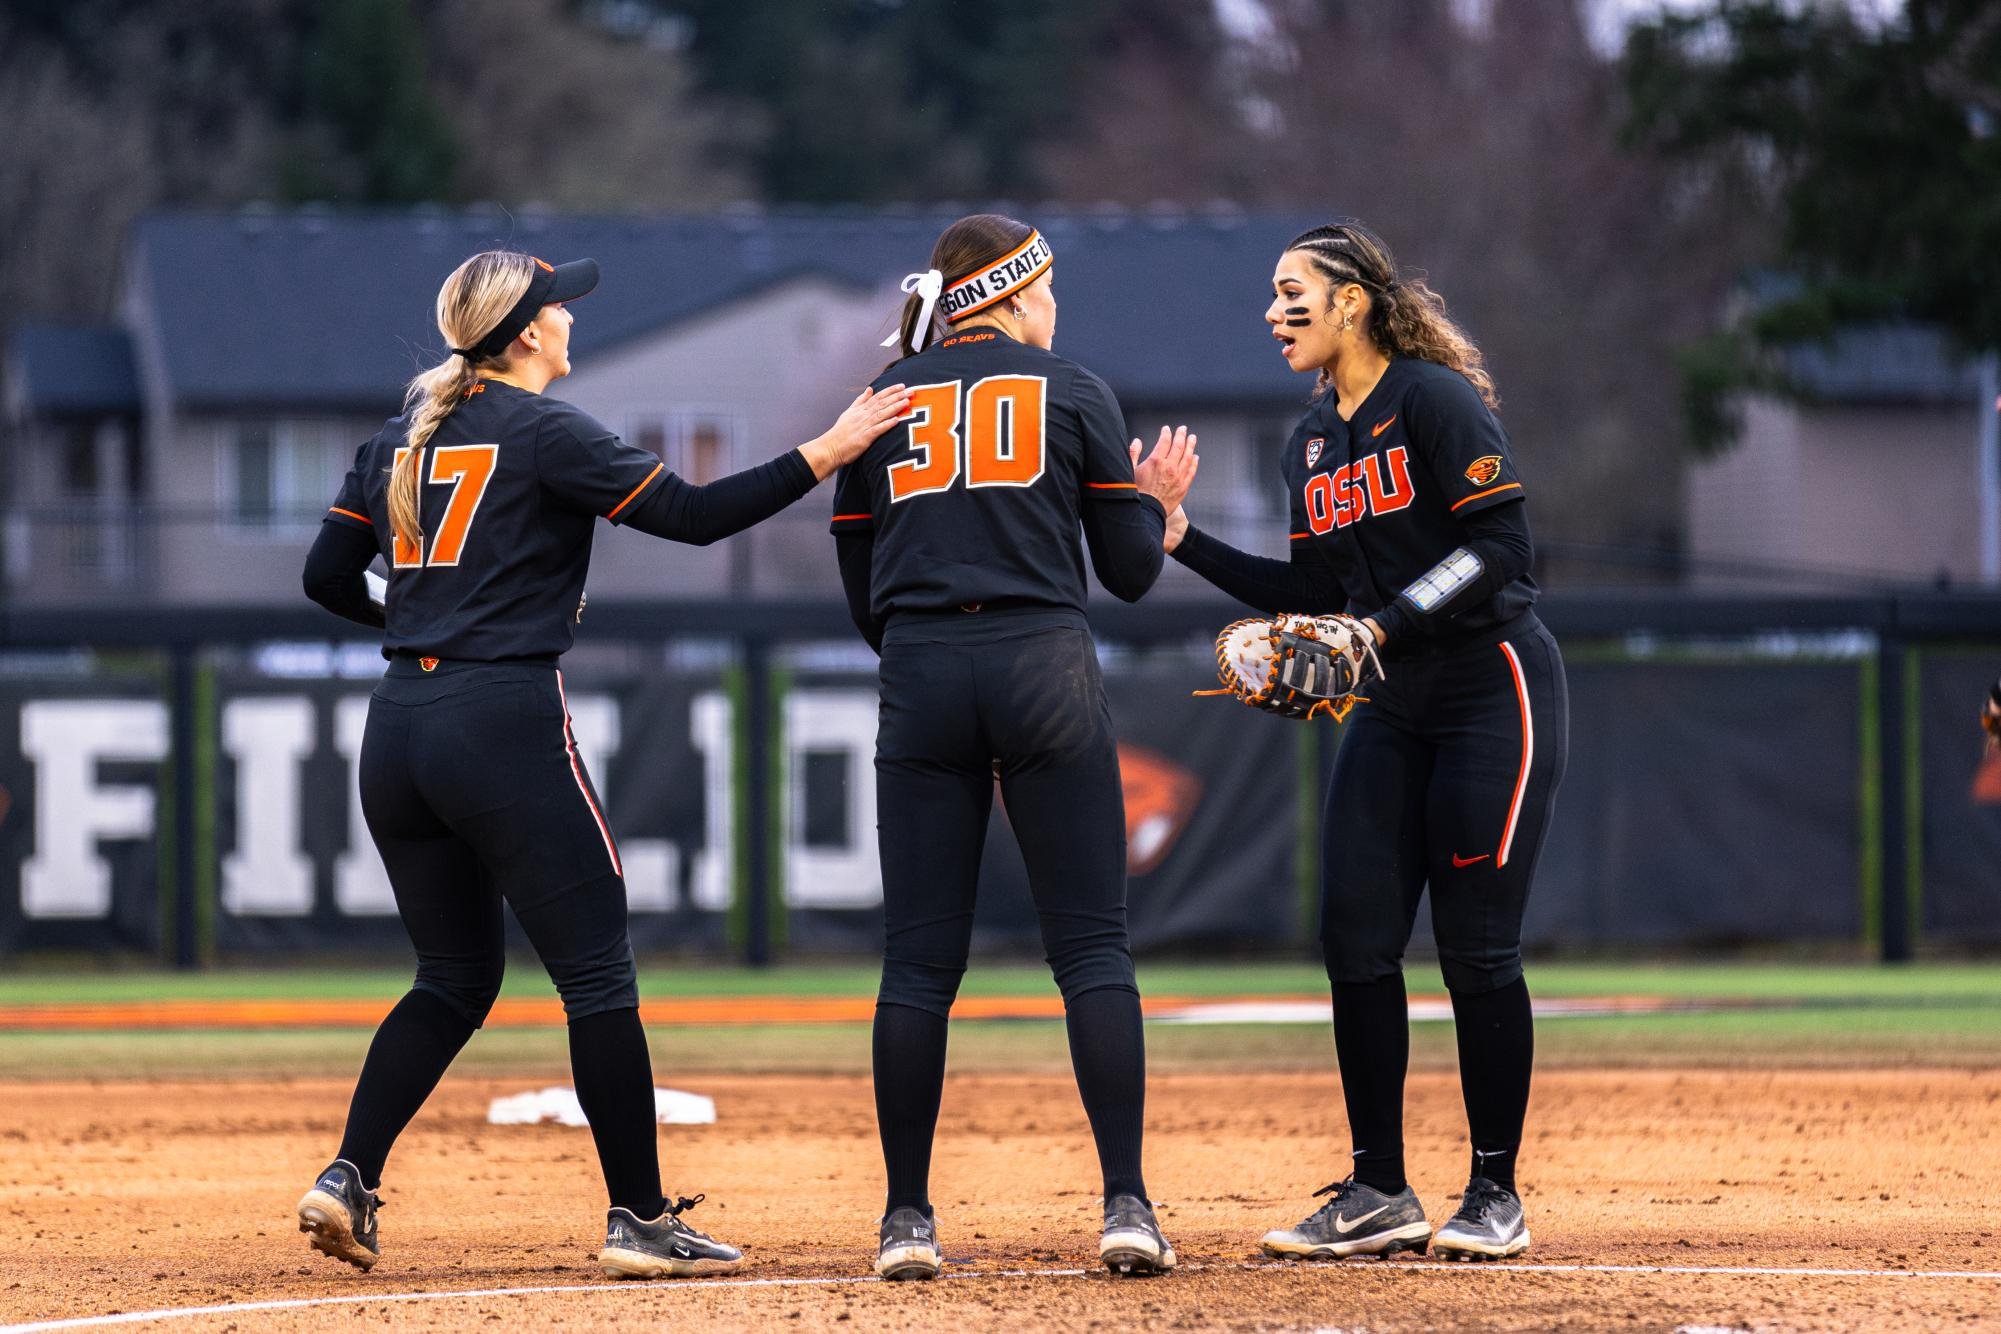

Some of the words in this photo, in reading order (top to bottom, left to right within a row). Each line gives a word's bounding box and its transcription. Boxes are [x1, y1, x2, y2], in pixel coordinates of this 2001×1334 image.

[988, 245, 1042, 291] STATE
[887, 374, 1047, 503] 30
[1306, 446, 1415, 534] OSU
[392, 444, 499, 568] 17
[19, 693, 884, 917] FID
